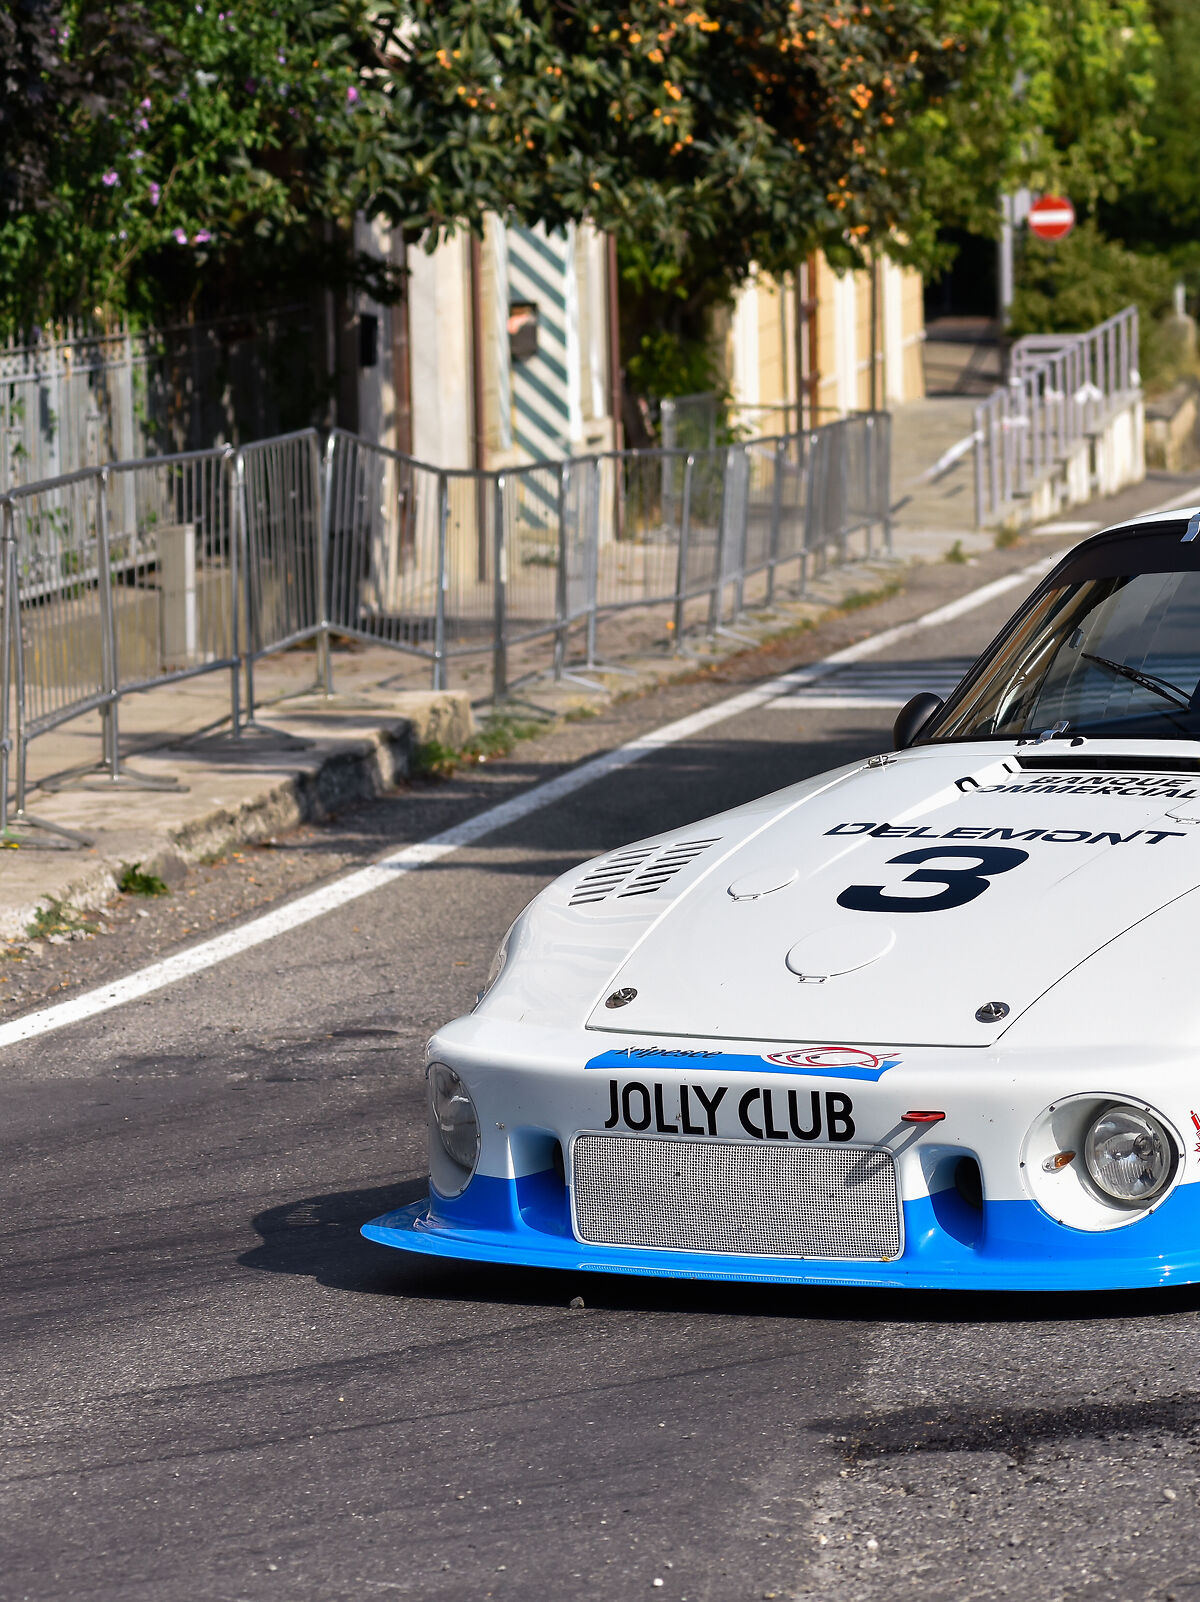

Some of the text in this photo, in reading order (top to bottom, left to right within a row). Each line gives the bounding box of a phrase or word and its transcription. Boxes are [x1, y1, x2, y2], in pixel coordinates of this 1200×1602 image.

[954, 776, 1198, 799] COMMERCIAL
[822, 821, 1188, 846] DELEMONT
[836, 845, 1030, 913] 3
[604, 1079, 856, 1142] JOLLY CLUB
